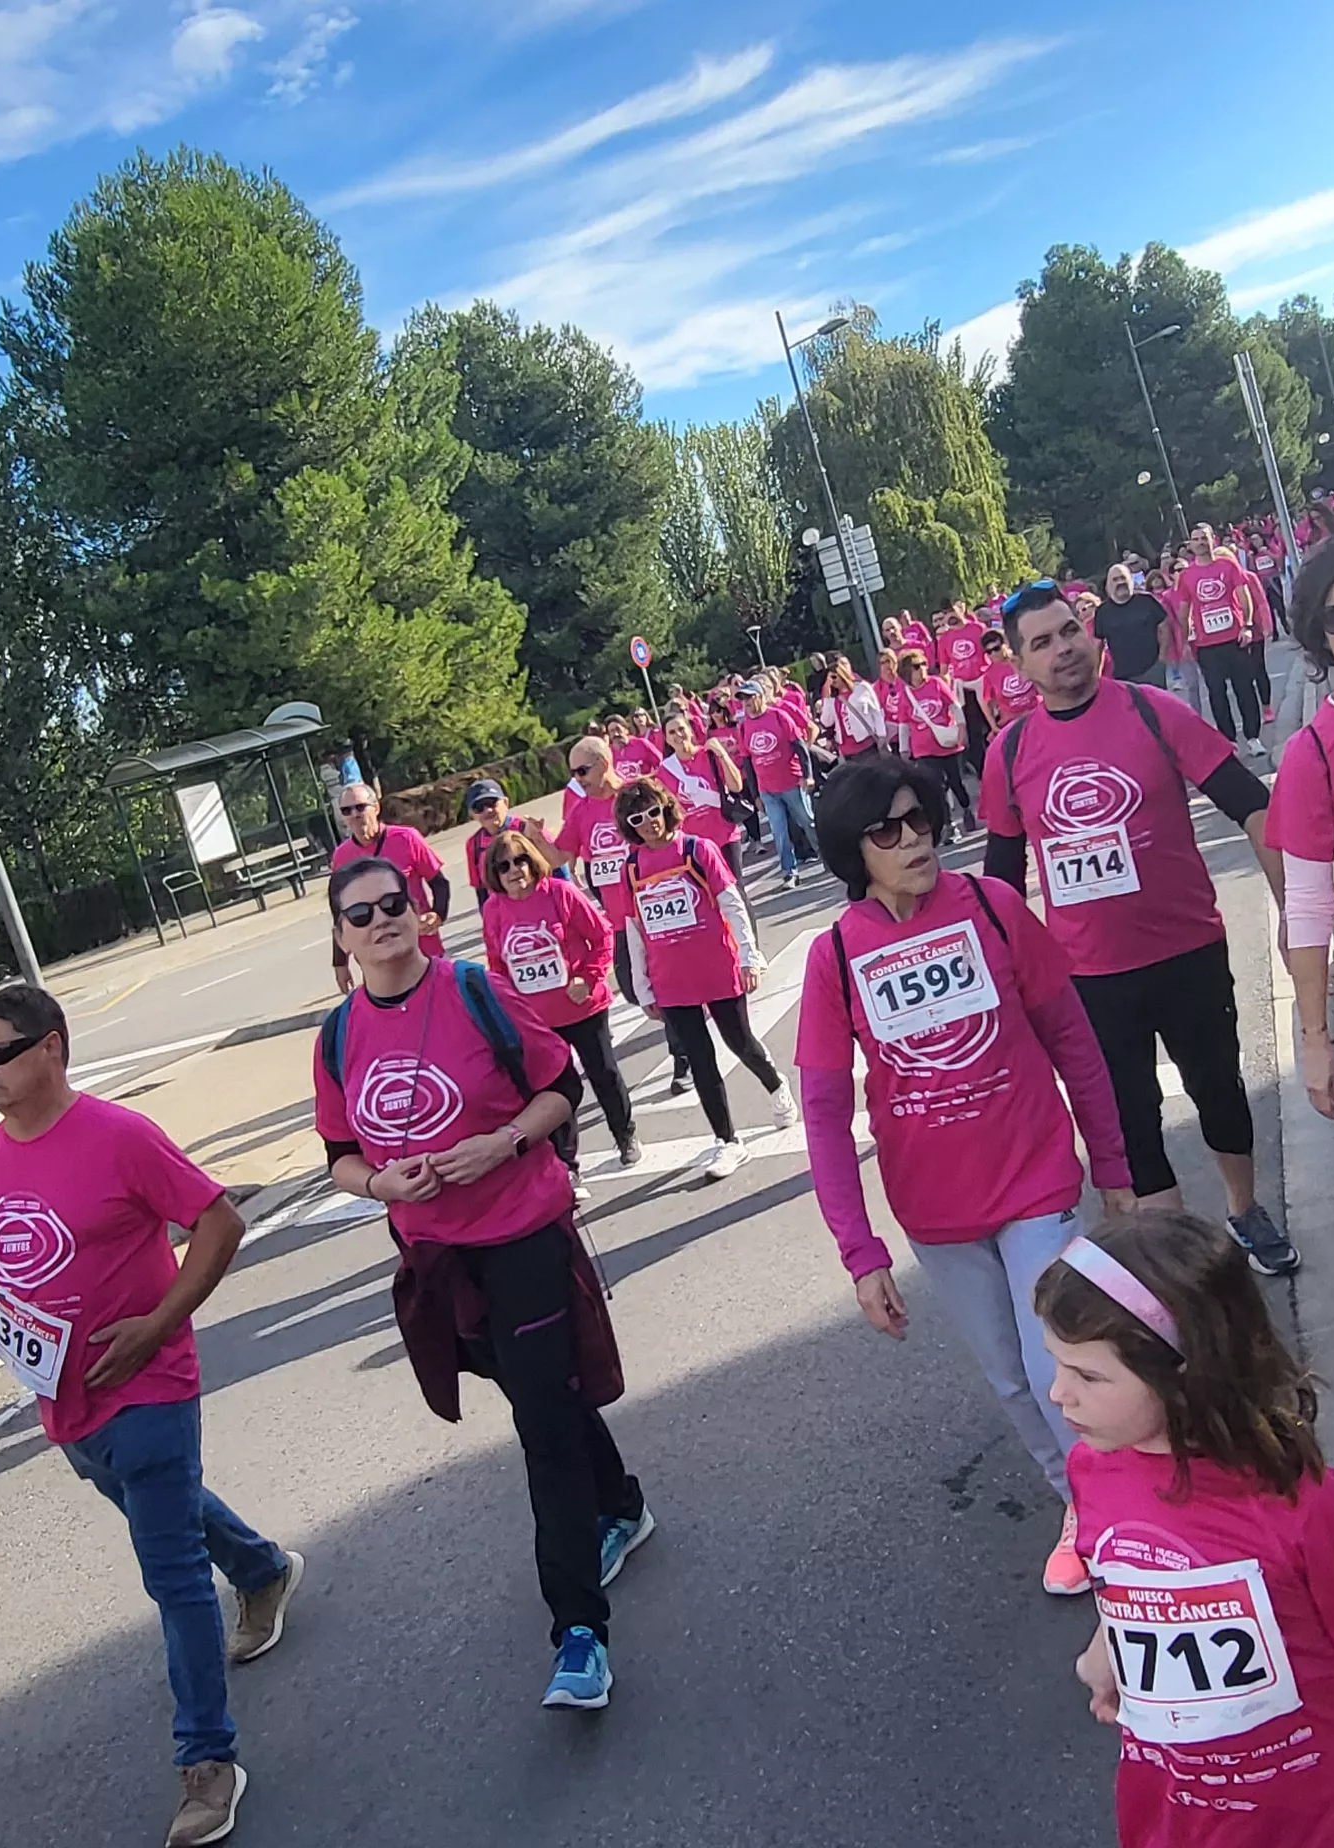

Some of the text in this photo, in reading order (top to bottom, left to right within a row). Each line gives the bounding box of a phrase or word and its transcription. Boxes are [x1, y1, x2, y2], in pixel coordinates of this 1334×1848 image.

[1057, 850, 1124, 884] 1714
[644, 899, 687, 921] 2942
[516, 960, 559, 982] 2941
[870, 957, 911, 979] CONTRA
[911, 953, 924, 964] EL
[875, 956, 975, 1012] 1599
[2, 1242, 30, 1253] JUNTOS
[0, 1317, 42, 1367] 319
[1128, 1589, 1174, 1604] HUESCA
[1146, 1604, 1165, 1621] EL
[1168, 1600, 1244, 1622] CÁNCER
[1108, 1626, 1267, 1692] 1712
